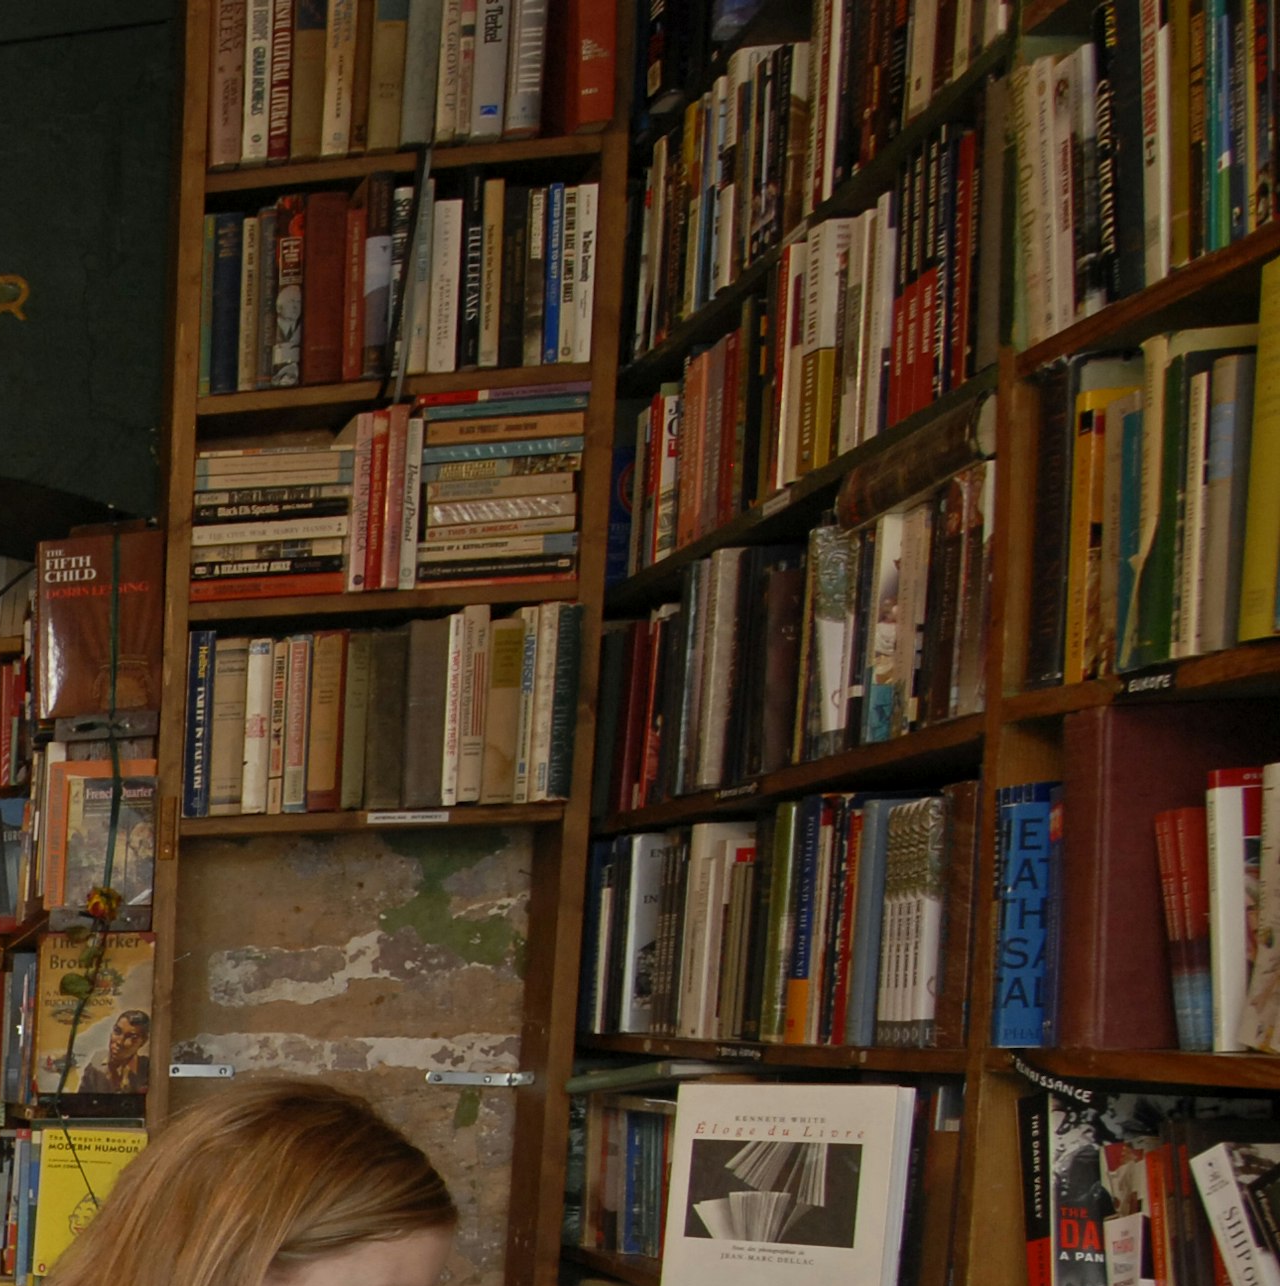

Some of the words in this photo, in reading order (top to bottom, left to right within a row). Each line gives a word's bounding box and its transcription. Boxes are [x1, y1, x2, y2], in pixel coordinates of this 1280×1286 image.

[485, 8, 503, 44] Terkel
[45, 549, 64, 558] THE
[45, 556, 91, 571] FIFTH
[44, 567, 97, 584] CHILD
[1127, 673, 1173, 694] EUROPE
[1014, 1057, 1093, 1103] RENAISSANCE
[735, 1115, 786, 1124] KENNETH
[791, 1116, 827, 1125] WHITE
[767, 1124, 791, 1137] du
[1059, 1205, 1089, 1219] THE
[1223, 1205, 1251, 1259] SHIP
